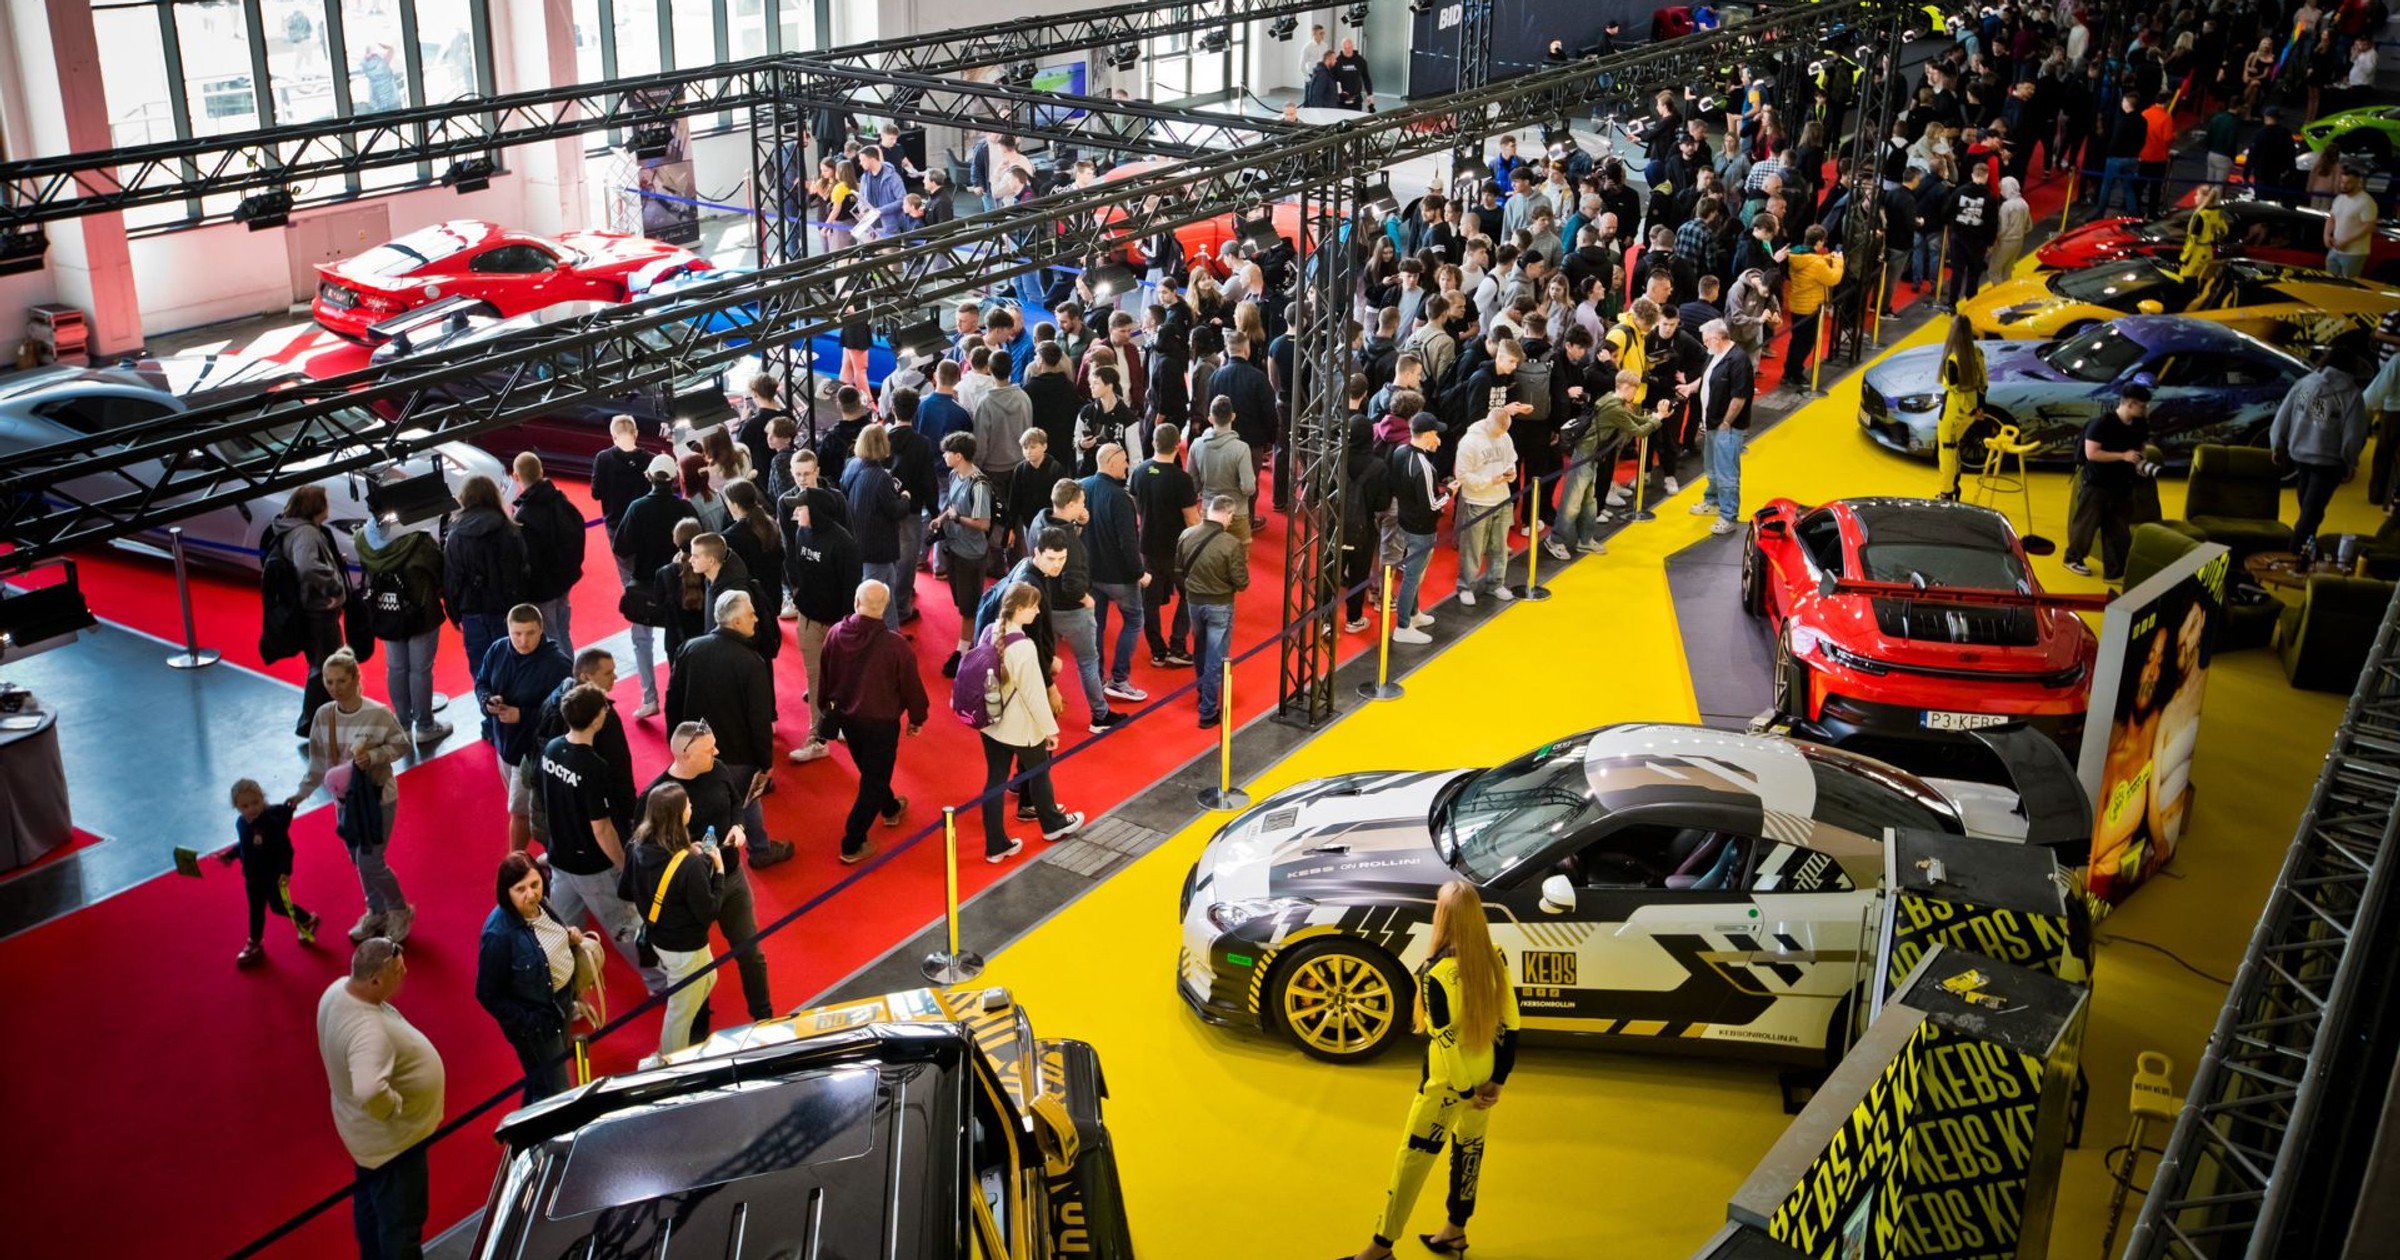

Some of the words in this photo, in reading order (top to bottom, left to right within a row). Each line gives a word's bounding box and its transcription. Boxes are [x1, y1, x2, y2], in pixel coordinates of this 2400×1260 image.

[1438, 4, 1462, 31] BID
[1287, 865, 1335, 879] KEBS
[1340, 862, 1356, 871] ON
[1524, 952, 1576, 984] KEBS
[1921, 1041, 2021, 1111] KEBS
